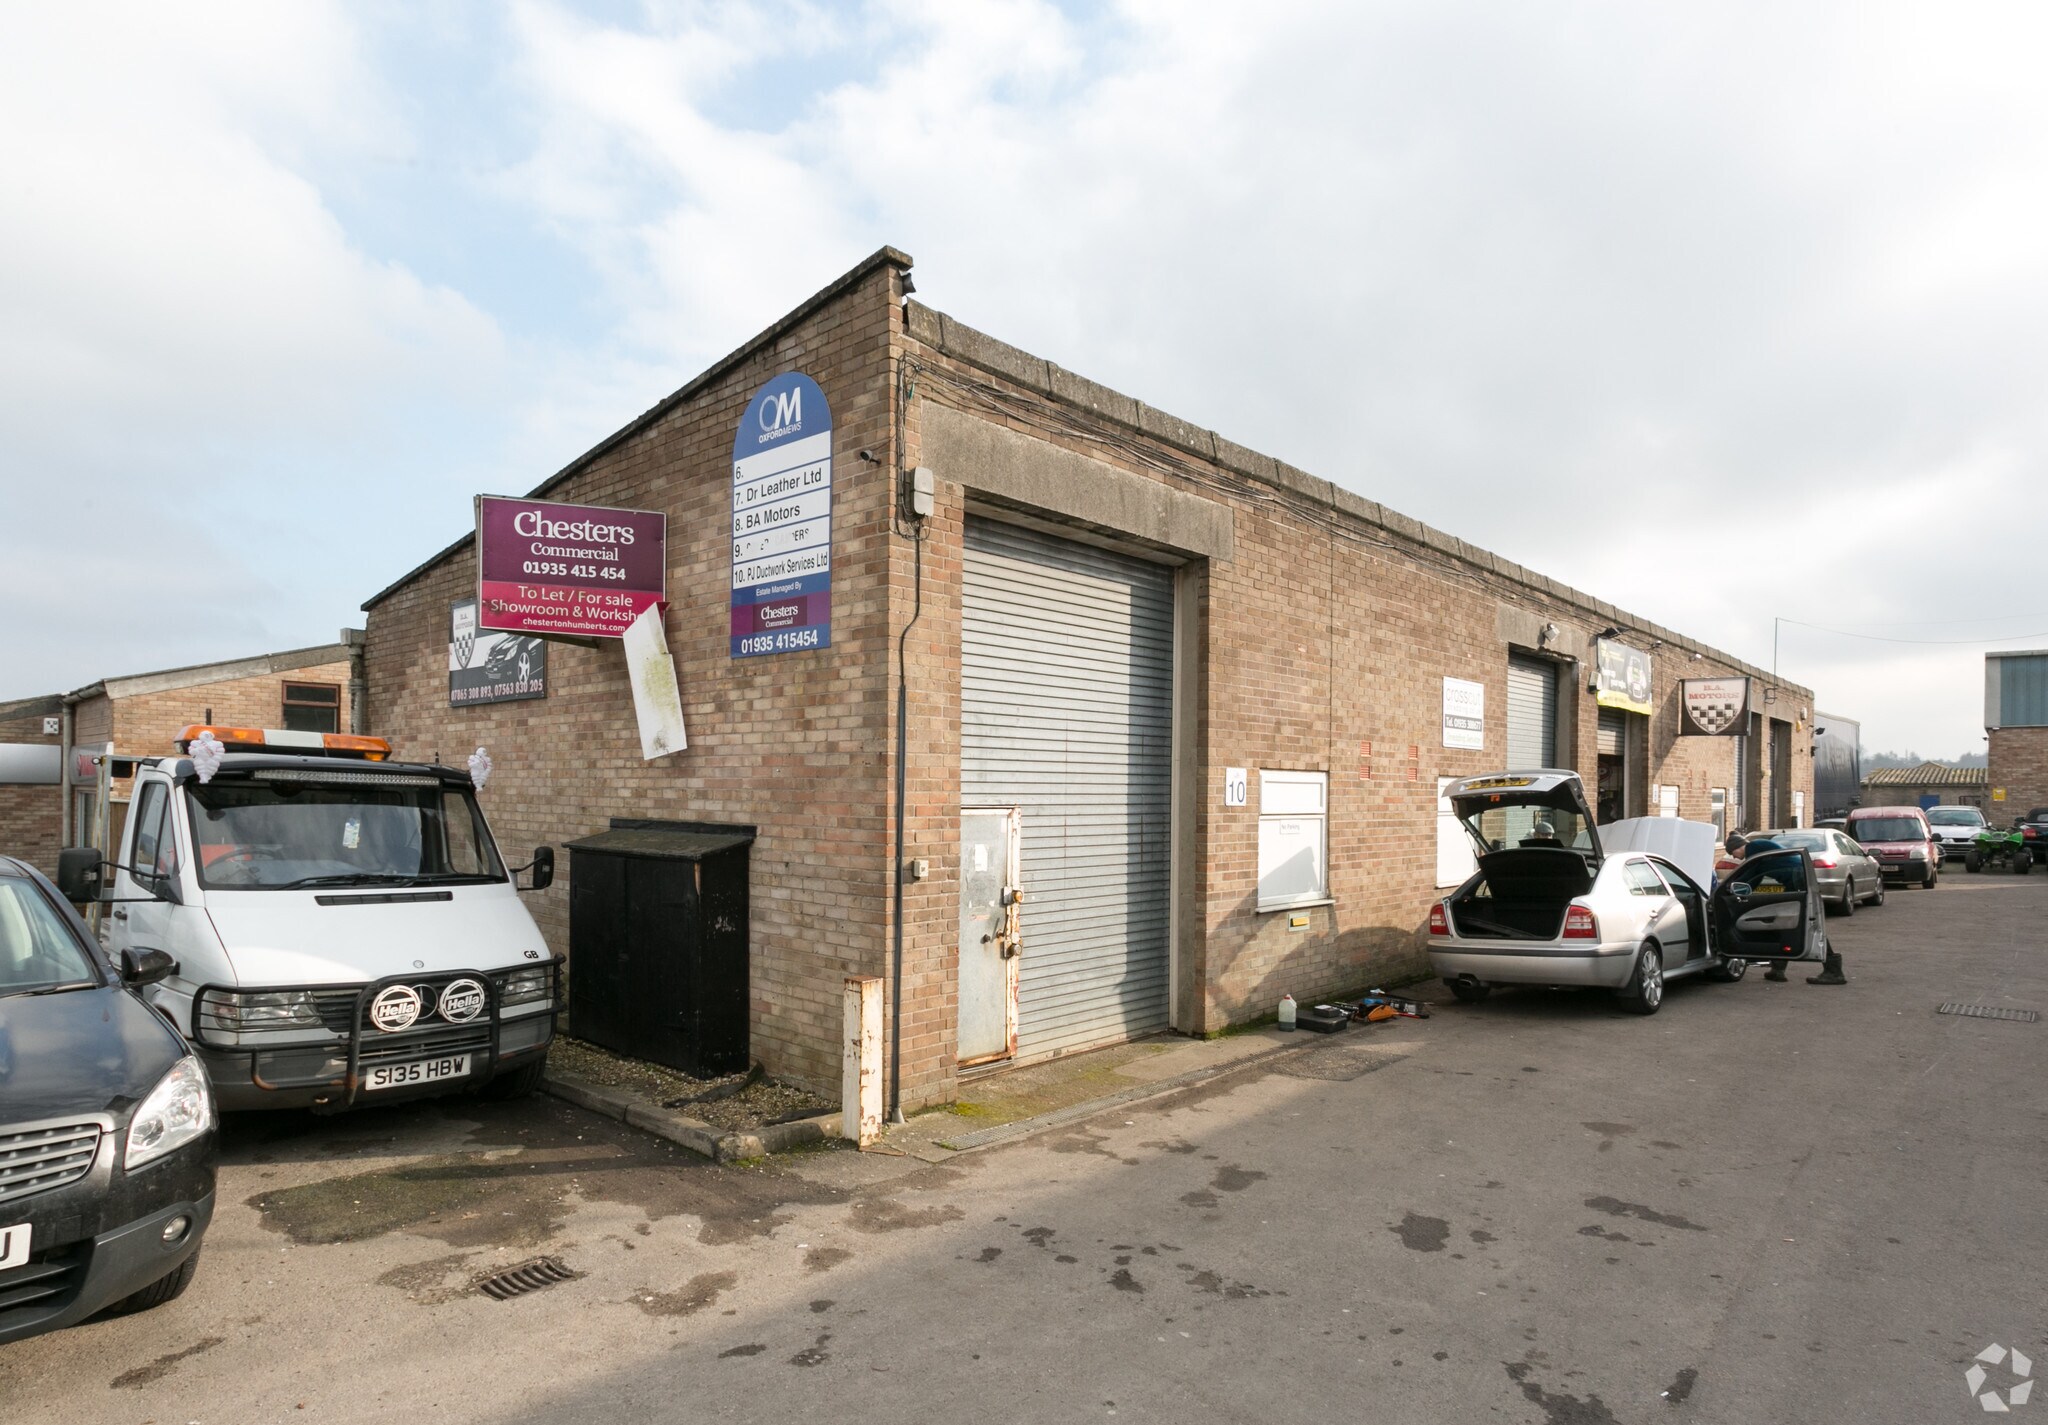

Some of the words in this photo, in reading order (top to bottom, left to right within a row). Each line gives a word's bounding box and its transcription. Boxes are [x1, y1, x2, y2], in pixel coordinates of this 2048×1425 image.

[759, 387, 802, 432] OM
[747, 488, 758, 502] Dr
[761, 477, 800, 497] Leather
[804, 468, 822, 486] Ltd
[747, 513, 761, 528] BA
[764, 505, 800, 525] Motors
[513, 510, 635, 545] Chesters
[531, 542, 619, 561] Commercial
[523, 561, 567, 576] 01935
[571, 565, 597, 578] 415
[600, 567, 626, 581] 454
[747, 566, 755, 581] PJ
[757, 561, 785, 579] Ductwork
[787, 557, 815, 573] Services
[817, 552, 828, 567] Ltd
[518, 585, 537, 599] To
[541, 587, 565, 602] Let
[578, 592, 603, 605] For
[606, 594, 633, 608] sale
[756, 586, 771, 597] Estate
[772, 583, 794, 595] Managed
[795, 581, 802, 591] By
[490, 599, 569, 616] Showroom
[573, 606, 583, 618] &
[761, 605, 798, 620] Chesters
[523, 617, 626, 632] chestertonhumberts.com
[765, 617, 793, 628] Commercial
[741, 635, 773, 654] 01935
[776, 629, 818, 649] 415454
[530, 679, 543, 692] 205
[1229, 781, 1245, 803] 10
[523, 950, 539, 959] GB
[379, 1003, 414, 1018] Hella
[448, 995, 480, 1011] Hella
[374, 1063, 421, 1086] S135
[426, 1057, 465, 1079] HBW
